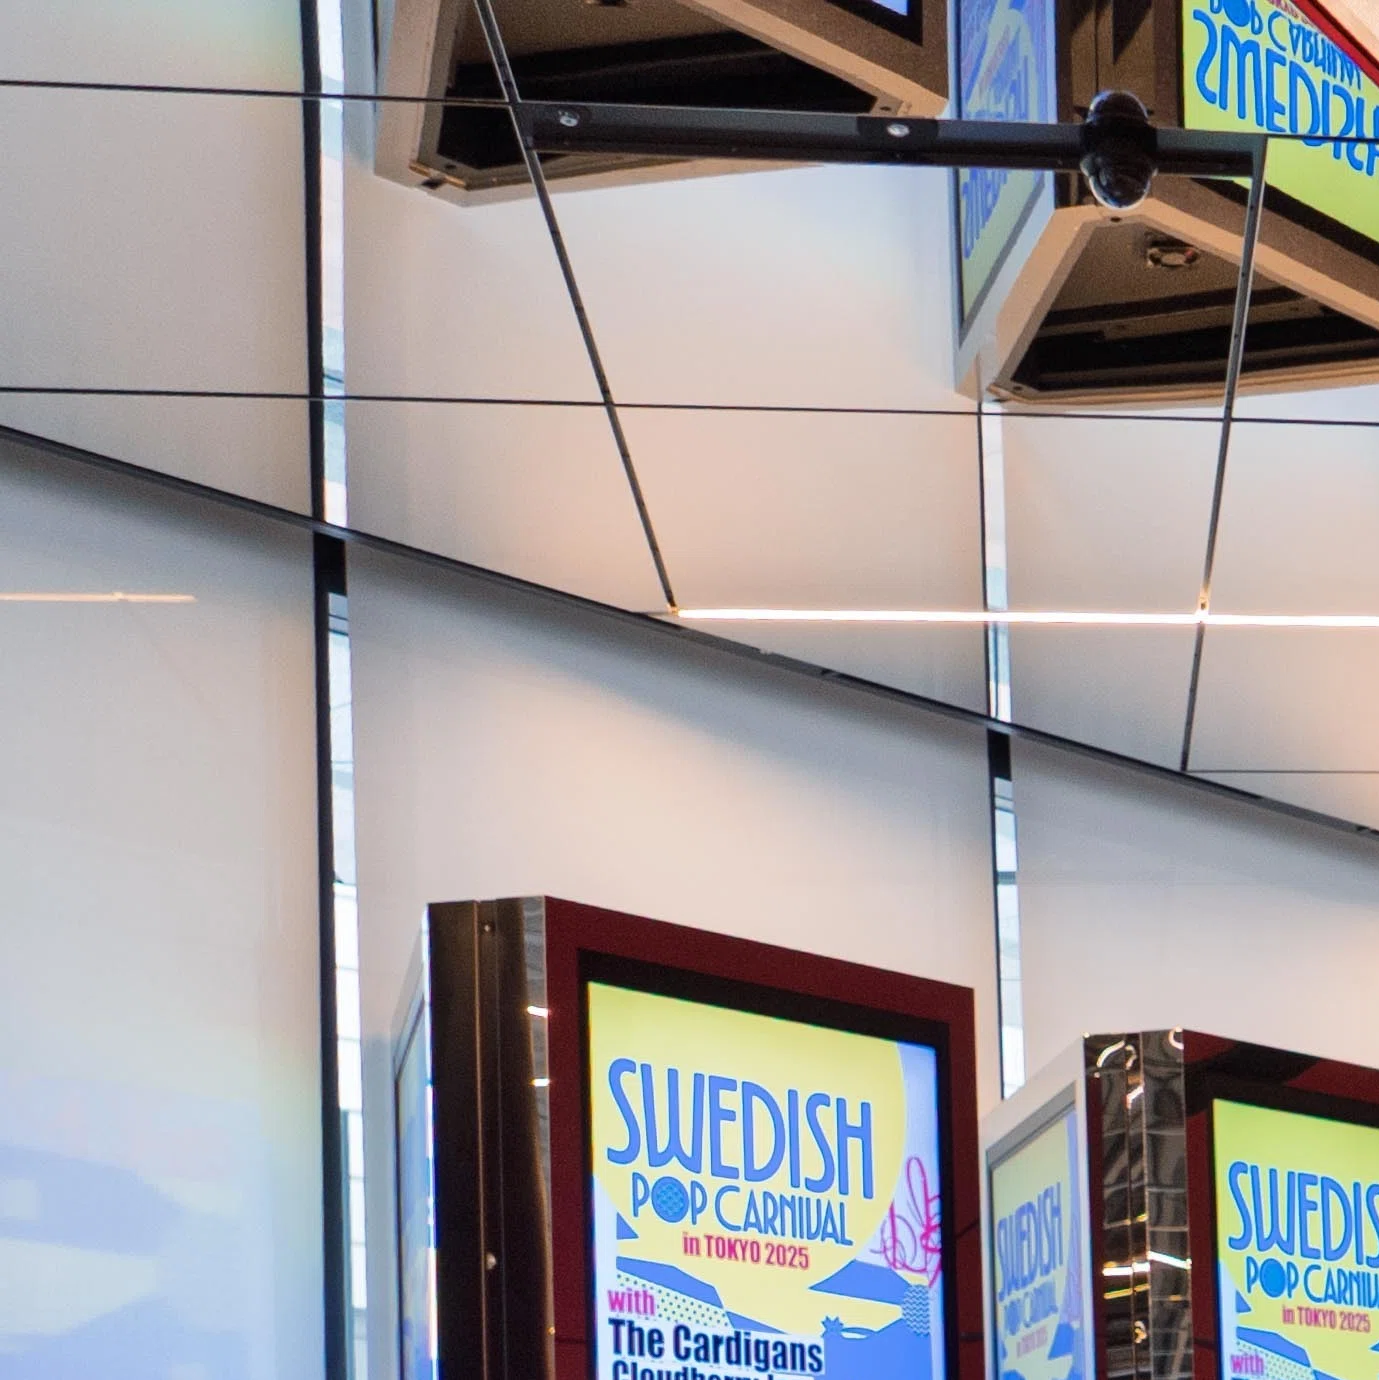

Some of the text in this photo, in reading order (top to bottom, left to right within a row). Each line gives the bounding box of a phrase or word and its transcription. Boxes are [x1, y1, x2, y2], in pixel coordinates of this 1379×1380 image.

[606, 1056, 874, 1200] SWEDISH
[631, 1171, 854, 1246] POP CARNIVAL
[683, 1231, 810, 1270] in TOKYO 2025
[1246, 1255, 1299, 1298] POP
[607, 1287, 655, 1316] with
[1282, 1304, 1371, 1333] in TOKYO 2025
[608, 1318, 824, 1374] The Cardigans
[1231, 1352, 1264, 1375] with
